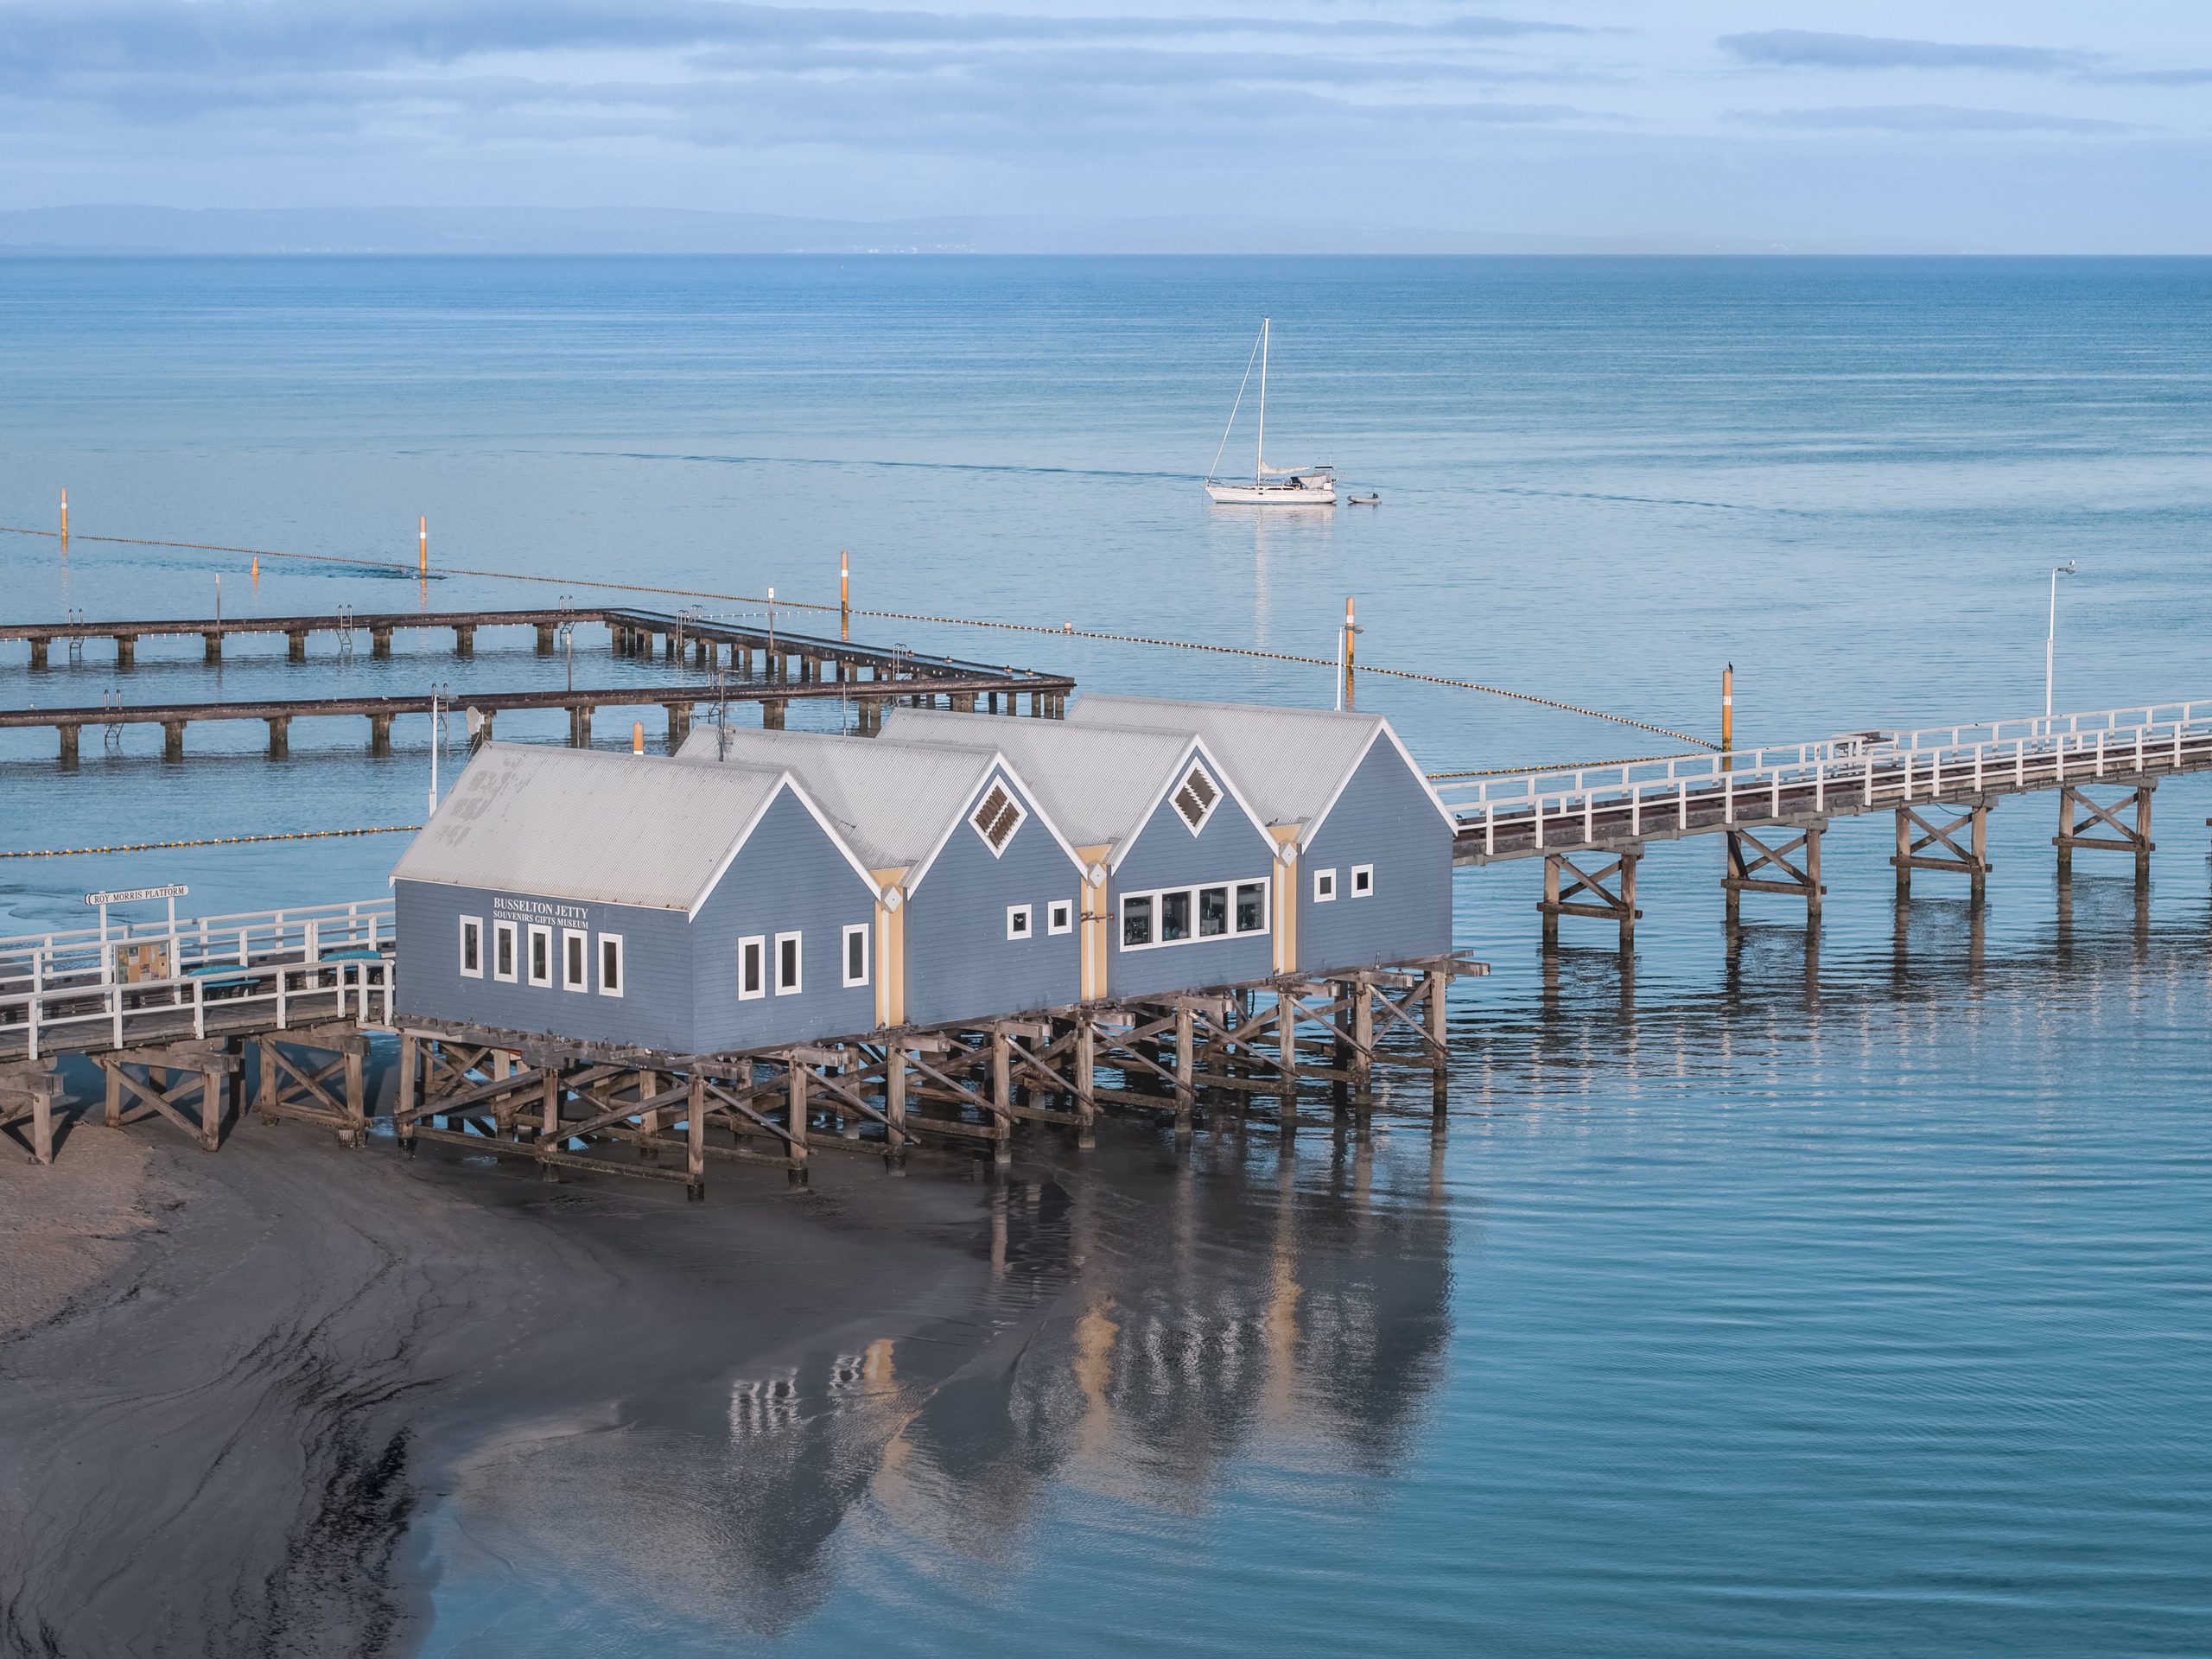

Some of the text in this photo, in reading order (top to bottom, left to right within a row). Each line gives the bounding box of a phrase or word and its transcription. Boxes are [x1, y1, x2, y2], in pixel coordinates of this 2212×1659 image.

[94, 887, 184, 903] ROY MORRIS PLATFORM
[493, 898, 588, 918] BUSSELTON JETTY
[493, 910, 588, 929] SOUVENIRS GIFTS MUSEUM
